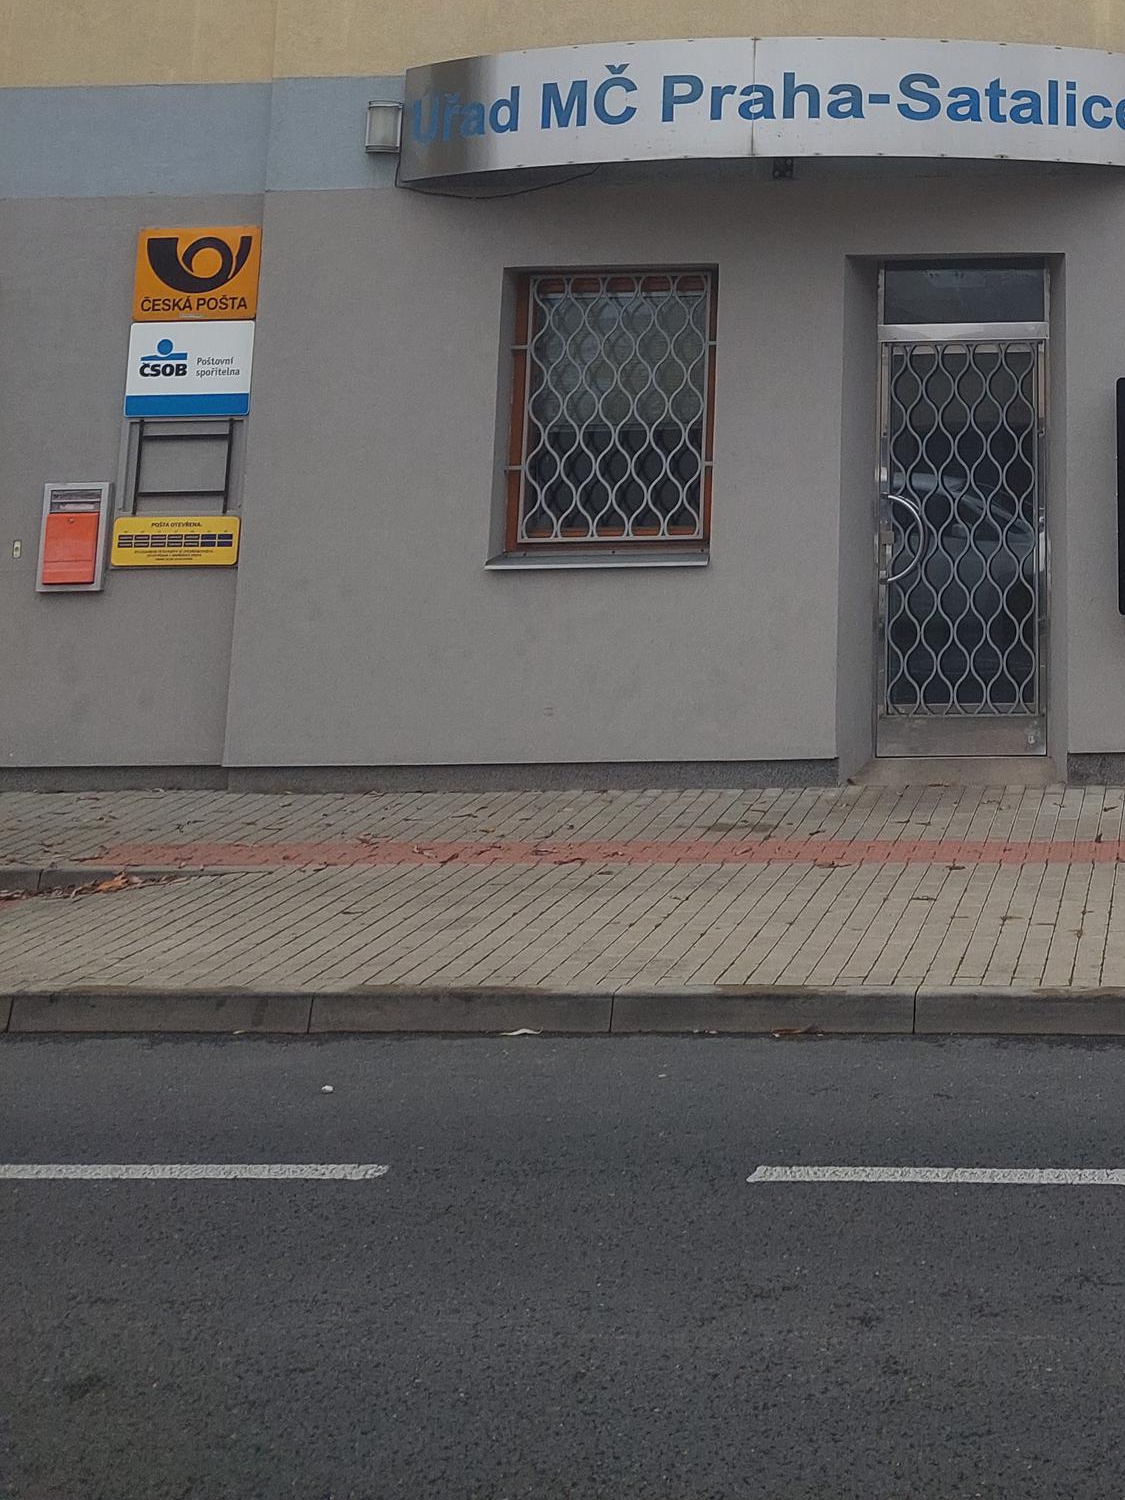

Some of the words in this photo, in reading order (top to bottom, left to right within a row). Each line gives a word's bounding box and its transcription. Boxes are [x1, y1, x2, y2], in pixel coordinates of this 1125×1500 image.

[540, 62, 639, 130] MČ
[140, 295, 193, 312] ČESKÁ
[196, 294, 248, 311] POŠTA
[196, 356, 234, 366] Poštovní
[139, 362, 188, 377] ČSOB
[195, 366, 240, 378] spořitelna
